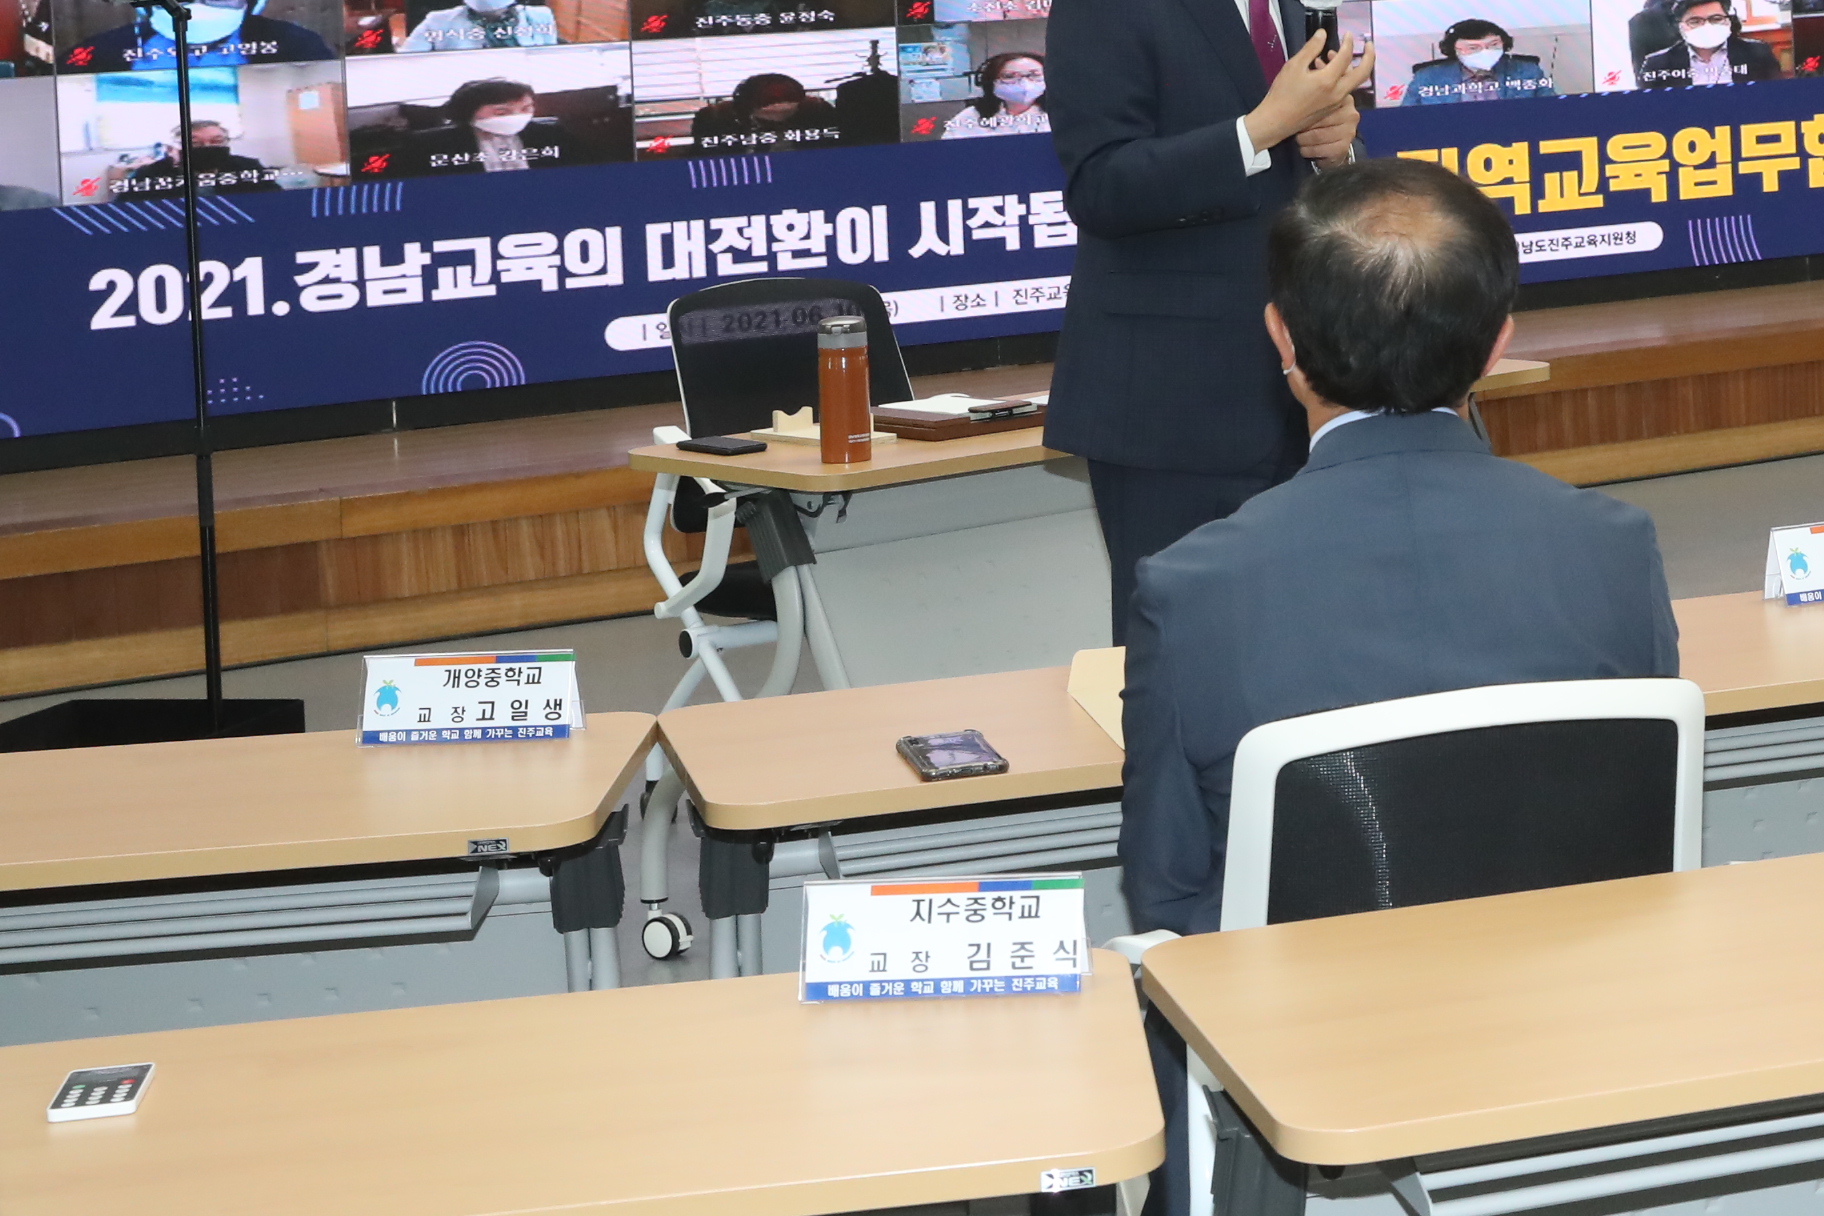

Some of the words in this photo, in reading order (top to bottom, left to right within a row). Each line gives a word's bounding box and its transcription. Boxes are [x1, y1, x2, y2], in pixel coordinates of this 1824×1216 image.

[1517, 229, 1637, 255] 남도진주교육지원청
[87, 225, 625, 331] 2021.경남교육의
[645, 203, 889, 284] 대전환이
[952, 293, 988, 312] 장소
[1799, 592, 1823, 603] 배움이
[443, 666, 543, 689] 개양중학교
[379, 731, 406, 743] 배움이
[410, 730, 437, 742] 즐거운
[441, 729, 460, 740] 학교
[463, 729, 482, 740] 함께
[486, 728, 513, 739] 가꾸는
[517, 726, 554, 737] 진주교육
[477, 840, 507, 853] NEX
[909, 894, 1041, 925] 지수중학교
[827, 983, 863, 998] 배움이
[870, 982, 905, 996] 즐거운
[910, 980, 935, 995] 학교
[940, 980, 964, 994] 함께
[970, 979, 1006, 993] 가꾸는
[1012, 977, 1059, 991] 진주교육
